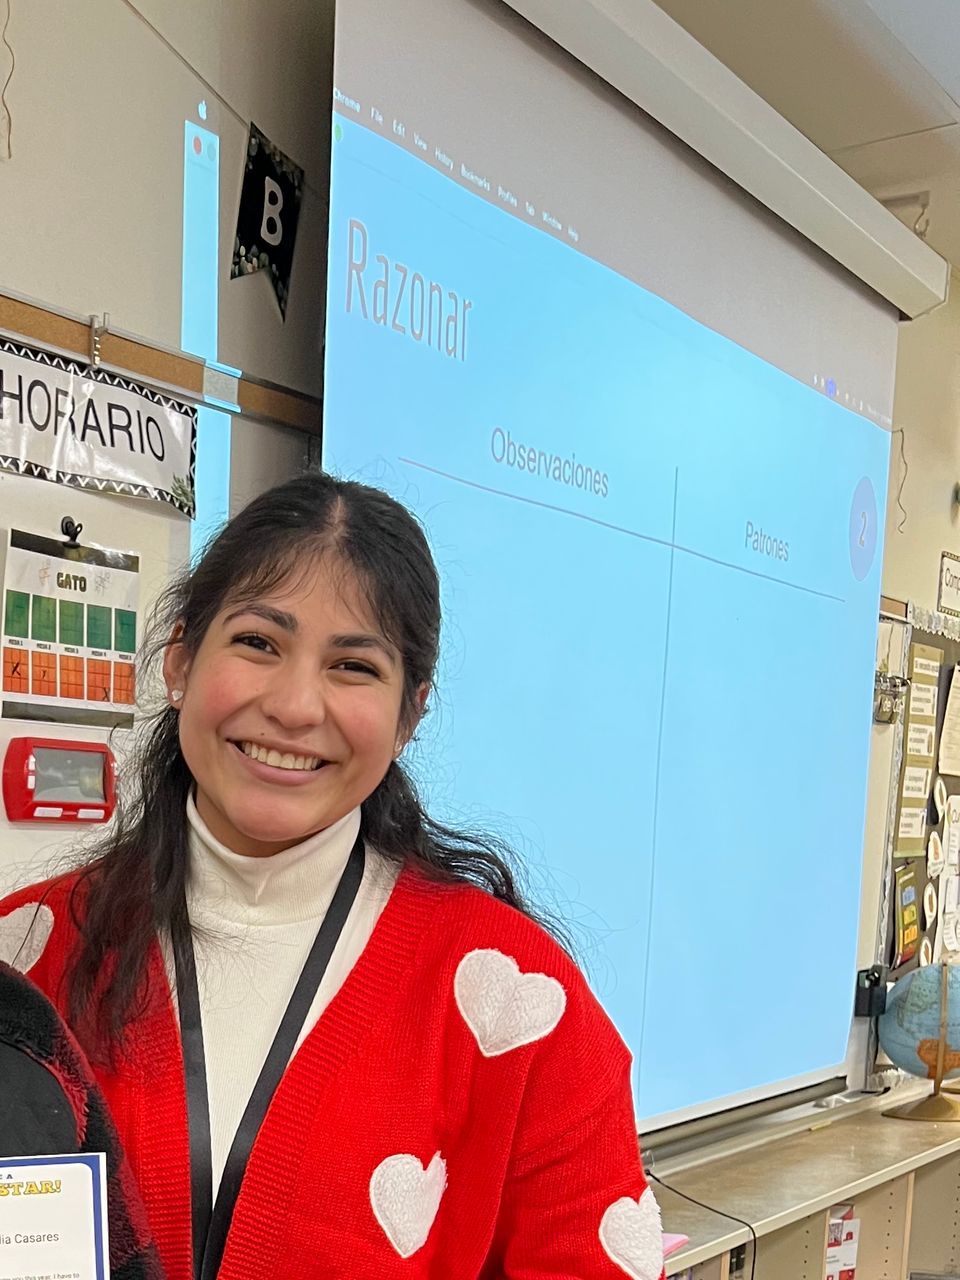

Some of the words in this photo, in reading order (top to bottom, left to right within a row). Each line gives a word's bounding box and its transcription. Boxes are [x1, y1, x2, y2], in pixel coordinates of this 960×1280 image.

[261, 176, 283, 246] B
[345, 217, 472, 362] Razonar
[490, 428, 610, 499] Observaciones
[744, 521, 789, 562] Patrones
[857, 511, 868, 548] 2
[57, 572, 87, 592] GATO
[15, 1232, 60, 1244] Casares
